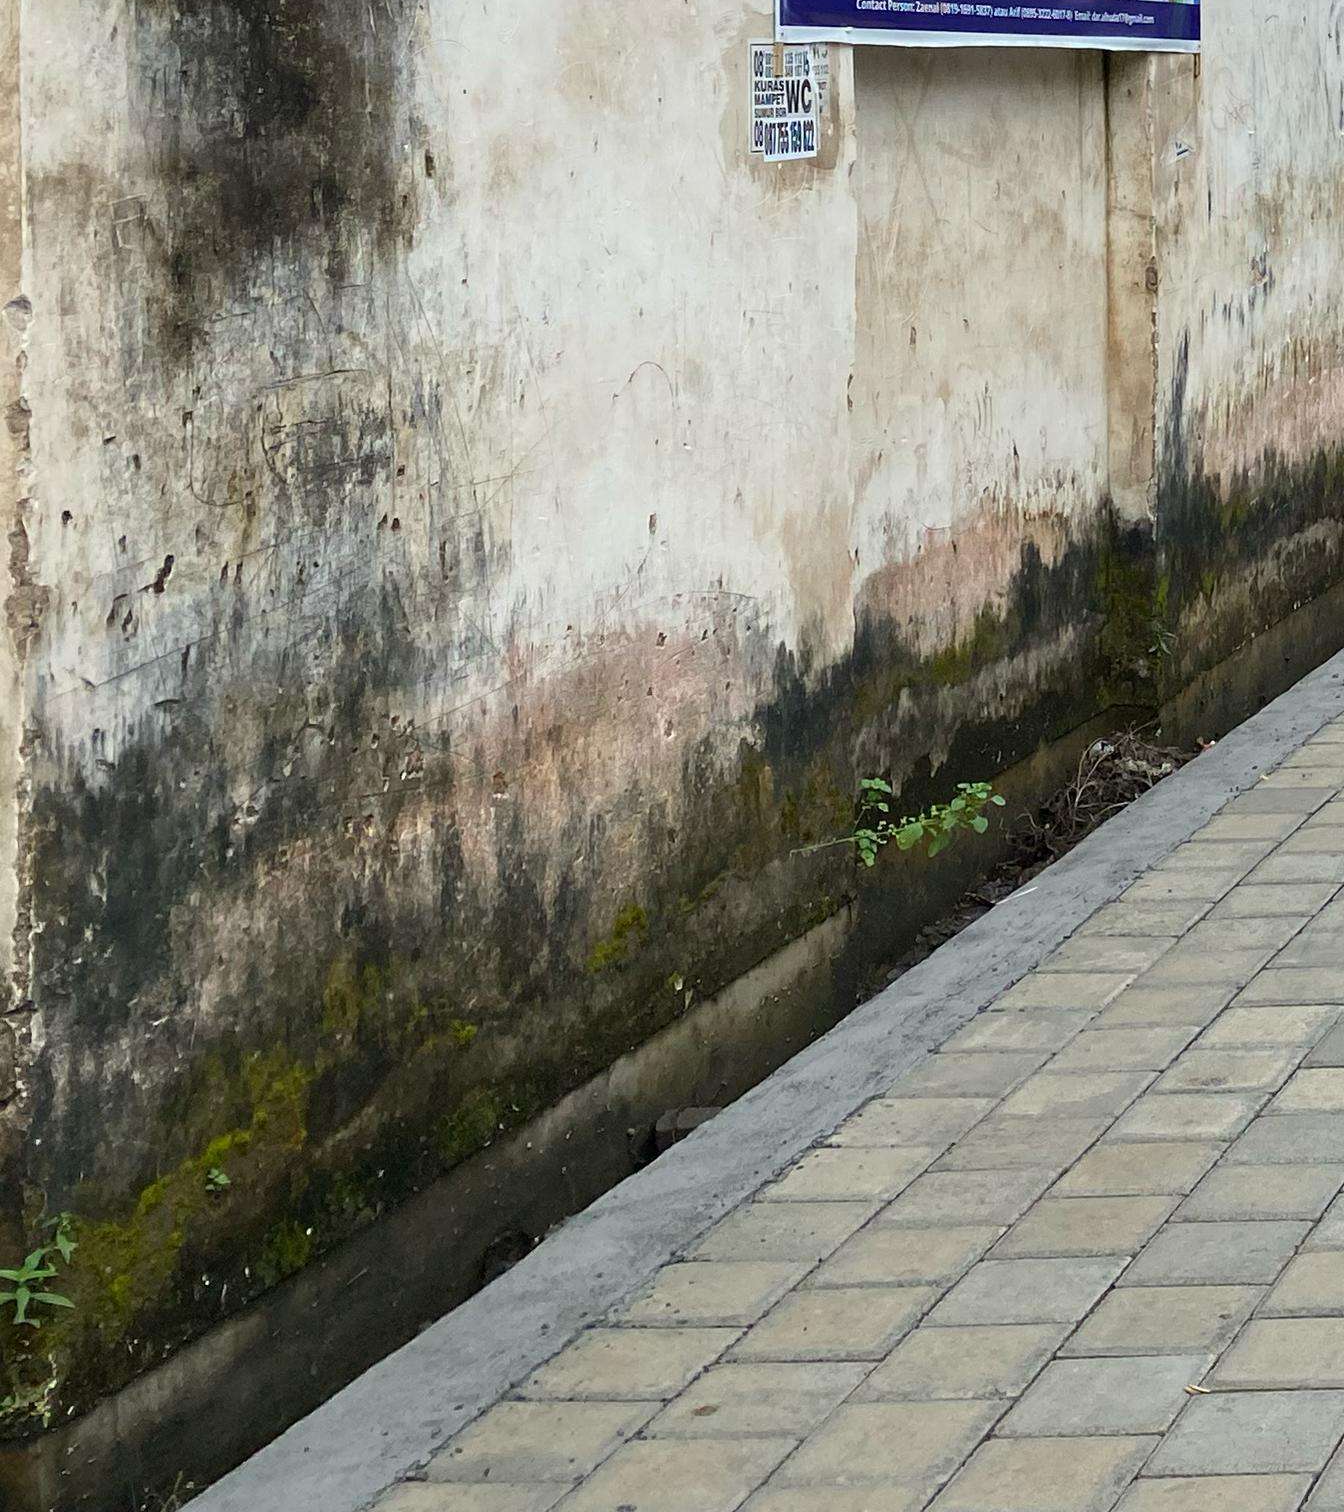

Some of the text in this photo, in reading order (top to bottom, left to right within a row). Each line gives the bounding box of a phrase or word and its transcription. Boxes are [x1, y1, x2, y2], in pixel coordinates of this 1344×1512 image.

[887, 0, 914, 12] Person:
[754, 80, 785, 92] KURAS
[754, 93, 785, 106] MAMPET
[786, 79, 812, 114] WC
